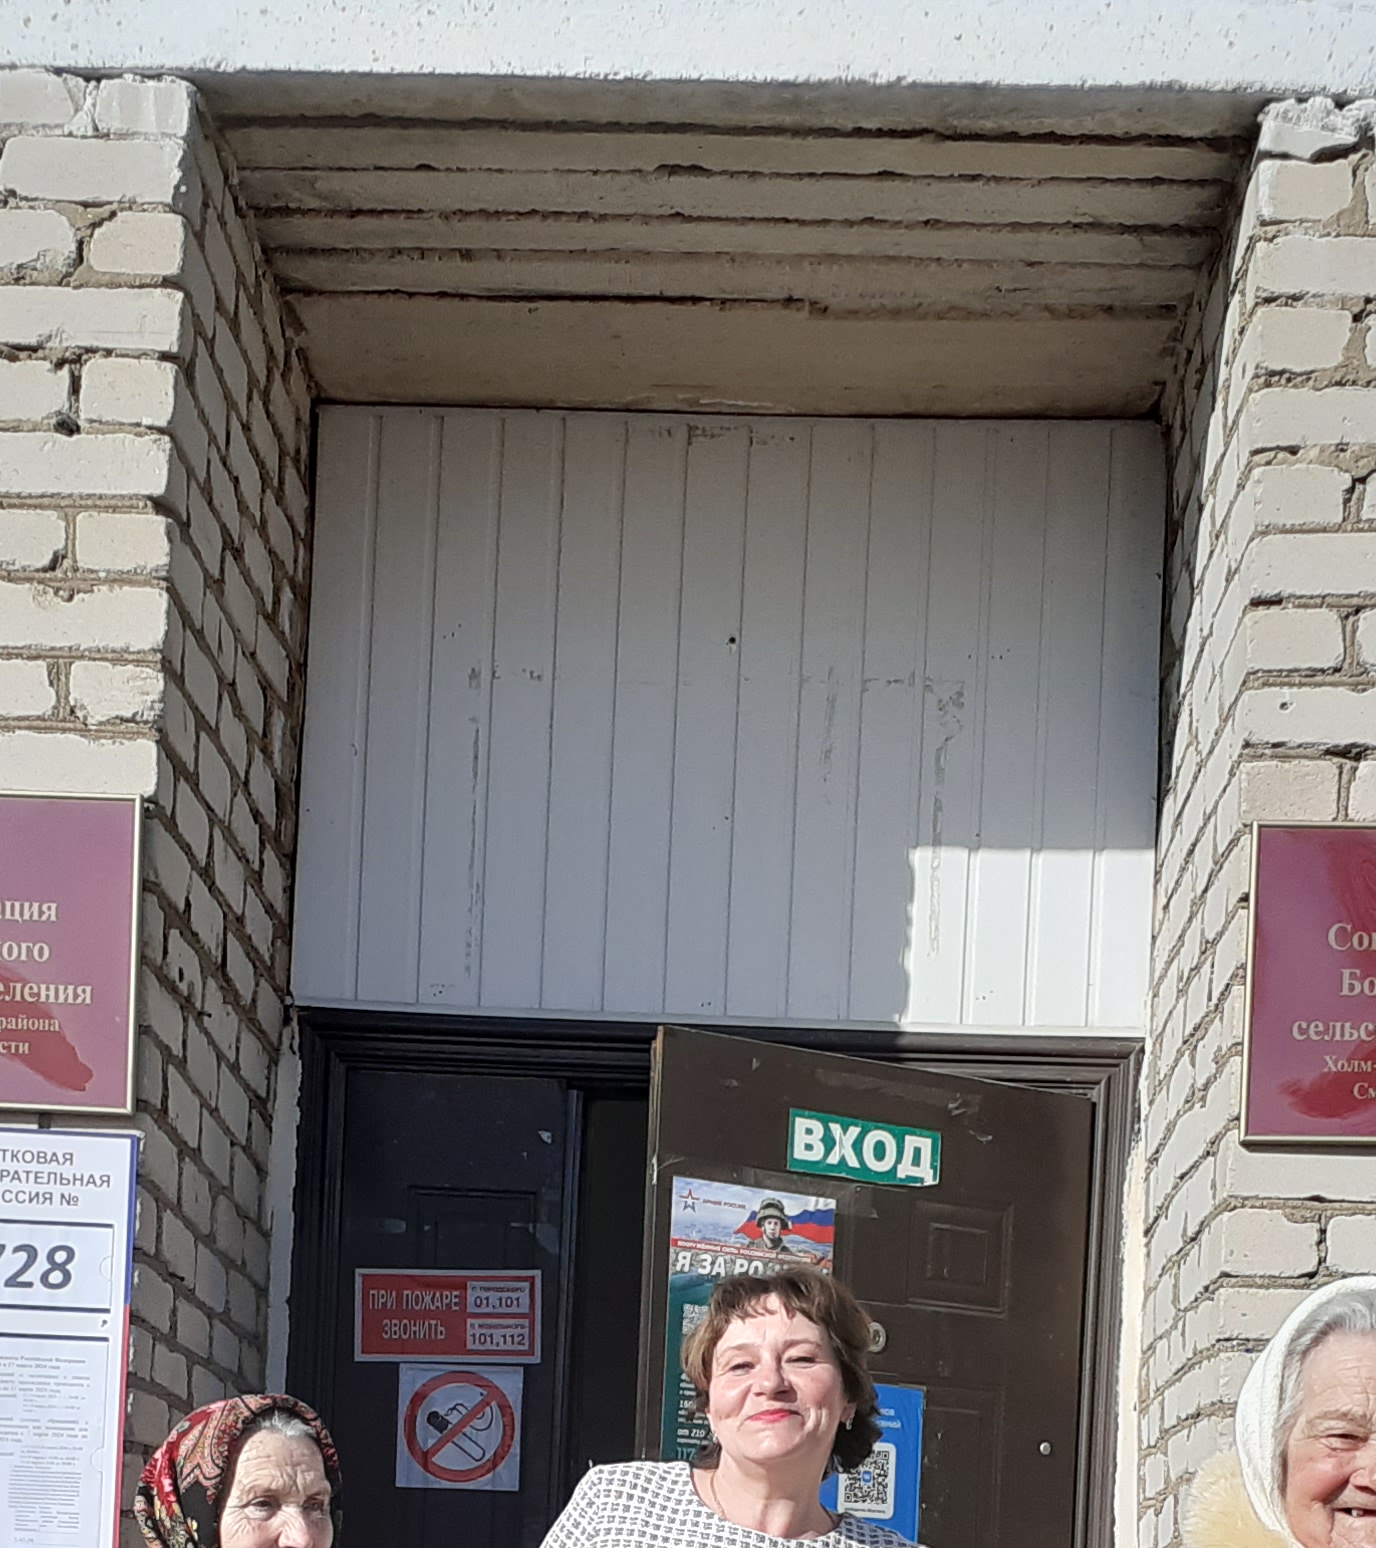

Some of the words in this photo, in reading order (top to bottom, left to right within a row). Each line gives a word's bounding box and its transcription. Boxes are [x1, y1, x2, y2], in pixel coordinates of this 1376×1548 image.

[792, 1116, 935, 1186] ВХОД
[59, 1192, 80, 1207] №
[676, 1251, 692, 1273] Я
[697, 1253, 726, 1277] ЗА
[369, 1289, 396, 1310] ПРИ
[402, 1290, 460, 1311] ПОЖАРЕ
[474, 1295, 520, 1310] 01,101
[381, 1318, 446, 1340] ЗВОНИТЬ
[469, 1332, 526, 1348] 101,112
